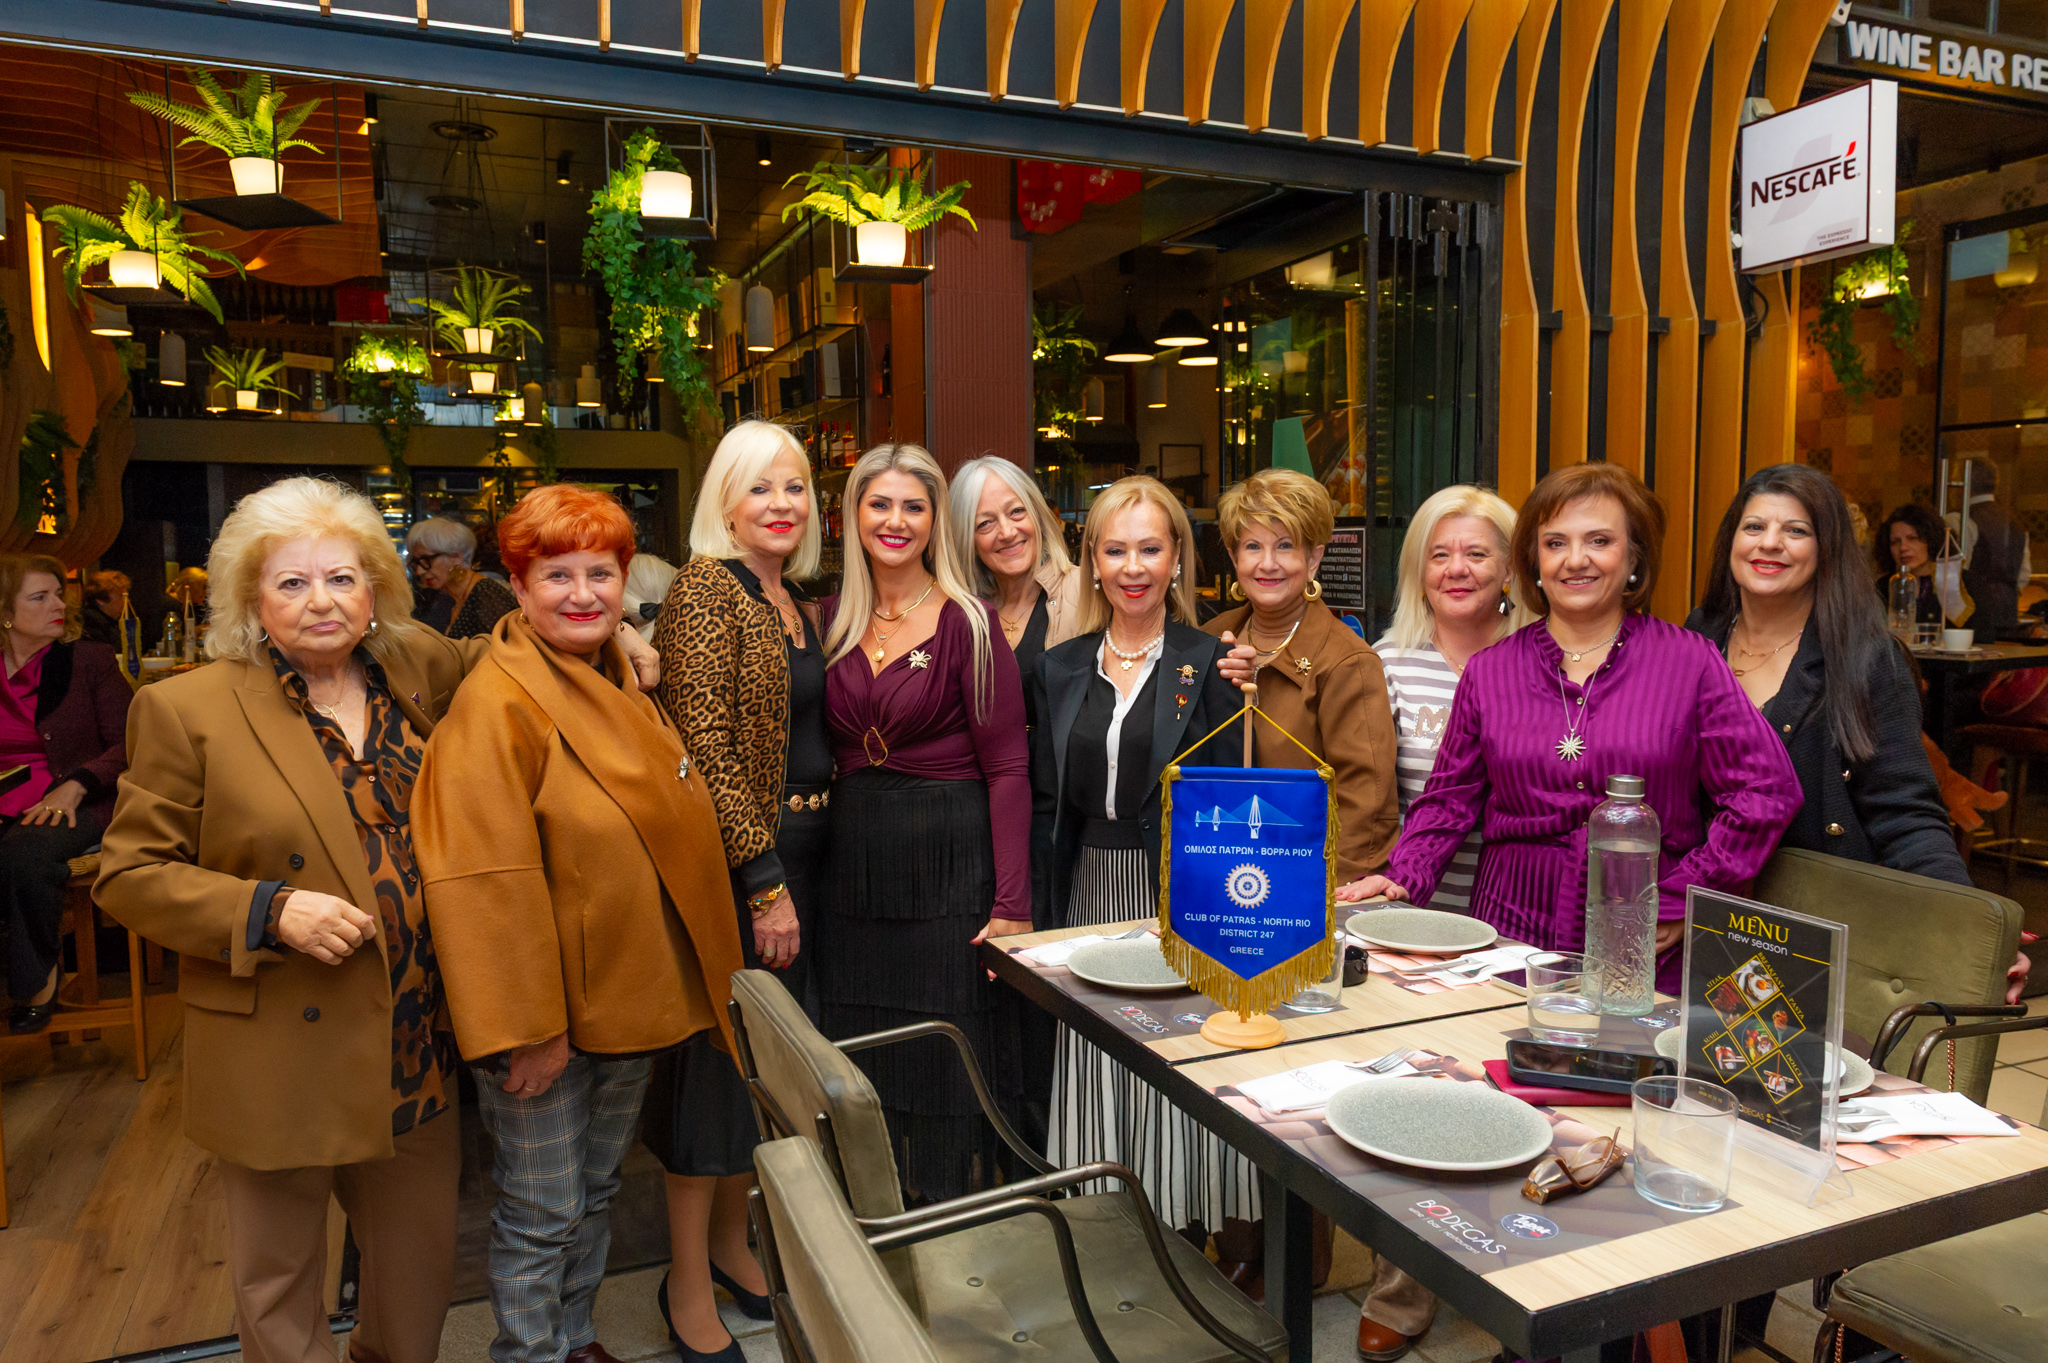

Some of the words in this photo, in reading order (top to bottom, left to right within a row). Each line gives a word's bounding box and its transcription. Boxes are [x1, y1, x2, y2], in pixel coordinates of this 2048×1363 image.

[1847, 20, 1932, 72] WINE
[1938, 40, 2006, 85] BAR
[1751, 141, 1858, 207] NESCAFÉ
[1819, 235, 1850, 246] EXPERIENCE
[1828, 228, 1853, 238] ESPRESSO
[1184, 845, 1217, 854] ΟΜΙΛΟΣ
[1218, 845, 1254, 855] ΠΑΤΡΩΝ
[1261, 847, 1290, 856] ΒΟΡΡΑ
[1292, 848, 1313, 857] ΡΙΟΥ
[1184, 913, 1207, 922] CLUB
[1209, 914, 1221, 922] OF
[1222, 915, 1256, 925] PATRAS
[1263, 917, 1293, 927] NORTH
[1296, 919, 1311, 927] RIO
[1728, 912, 1790, 943] MENU
[1219, 928, 1258, 938] DISTRICT
[1260, 930, 1275, 939] 247
[1727, 931, 1750, 944] new
[1751, 938, 1788, 955] season
[1229, 946, 1265, 955] GREECE
[1706, 974, 1724, 988] STEAK
[1757, 951, 1785, 989] BREAKFAST
[1788, 997, 1805, 1020] PASTA
[1703, 1030, 1720, 1044] SUSHI
[1785, 1053, 1803, 1077] DOLCE
[1416, 1199, 1507, 1255] BODEGAS
[1443, 1229, 1480, 1255] restaurant
